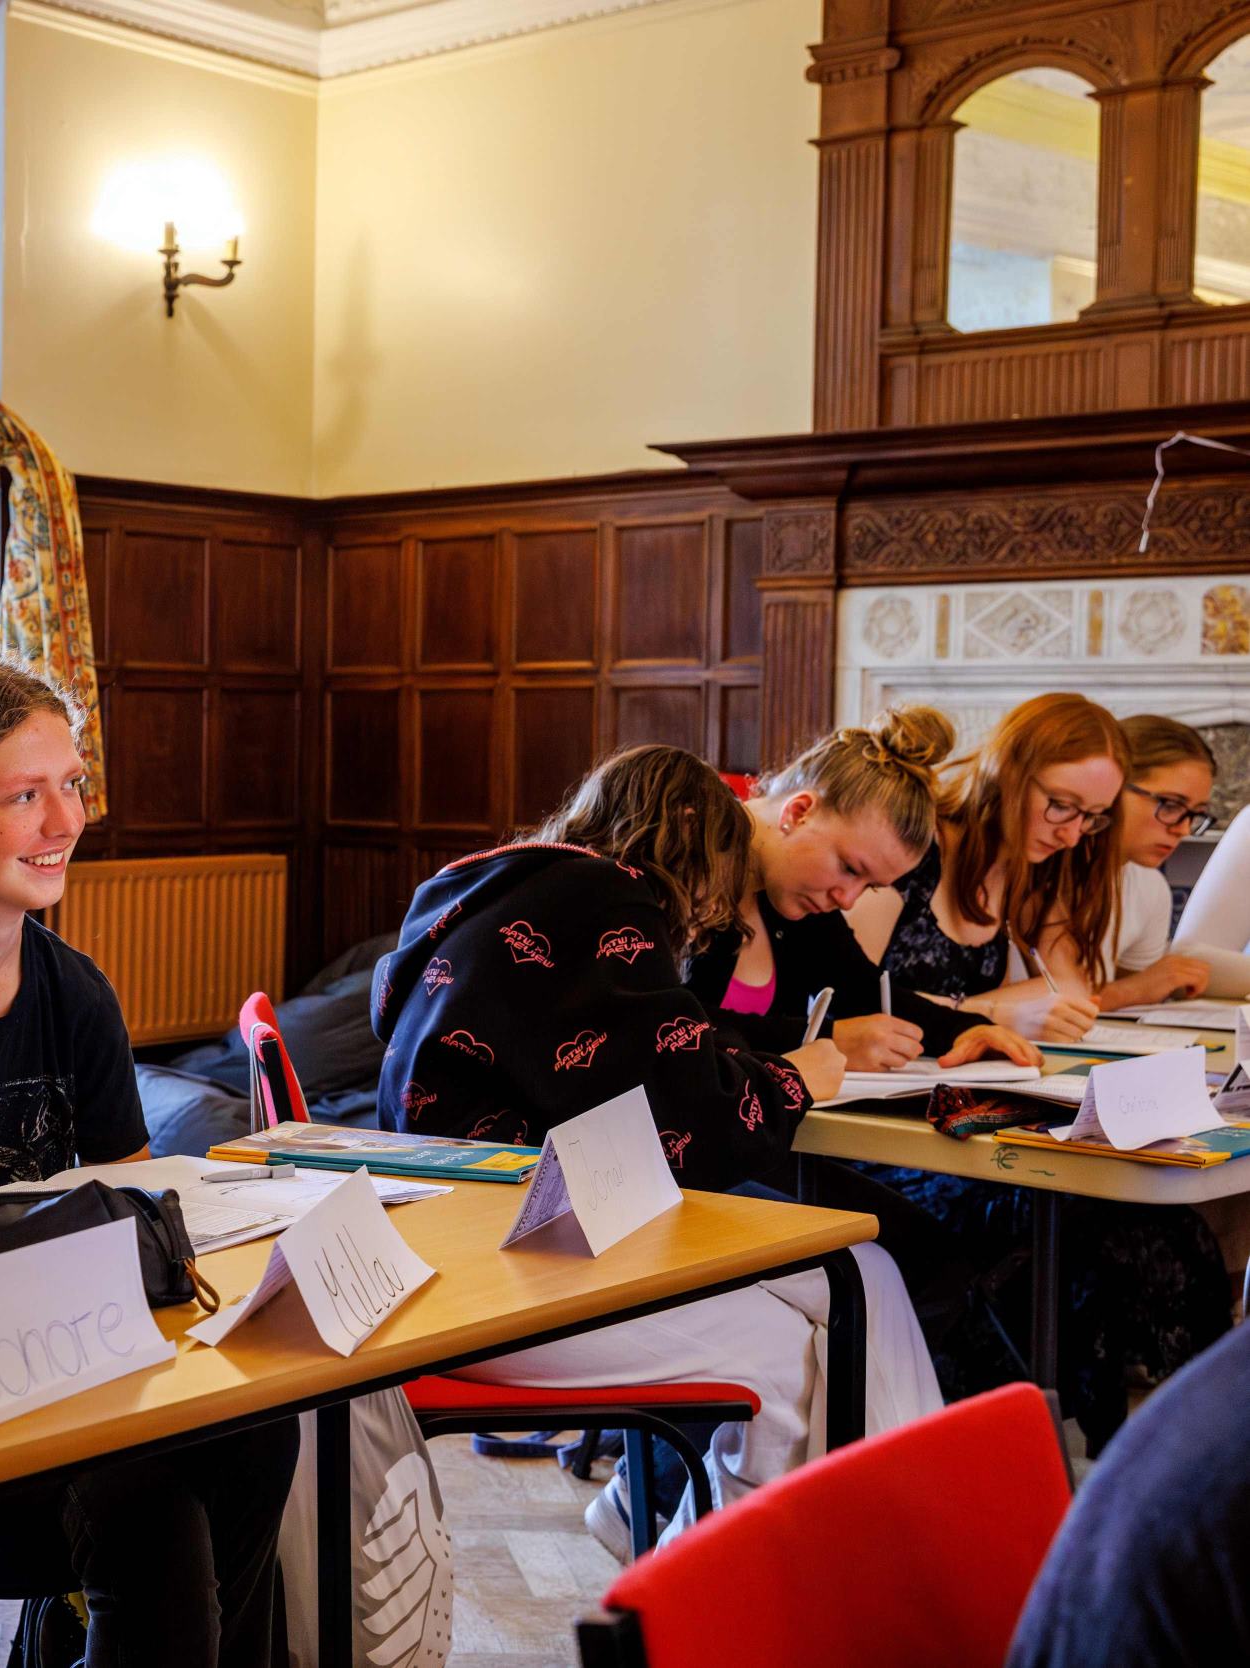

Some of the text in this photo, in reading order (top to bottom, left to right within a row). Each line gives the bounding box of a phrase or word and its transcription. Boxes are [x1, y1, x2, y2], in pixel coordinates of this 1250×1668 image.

[499, 926, 535, 947] MATW
[606, 941, 654, 958] REVIEW
[505, 936, 555, 969] REVIEW
[440, 1034, 477, 1057] MATW
[565, 1032, 607, 1070] REVIEW
[656, 1026, 686, 1054] MATW
[554, 1043, 584, 1072] MATW
